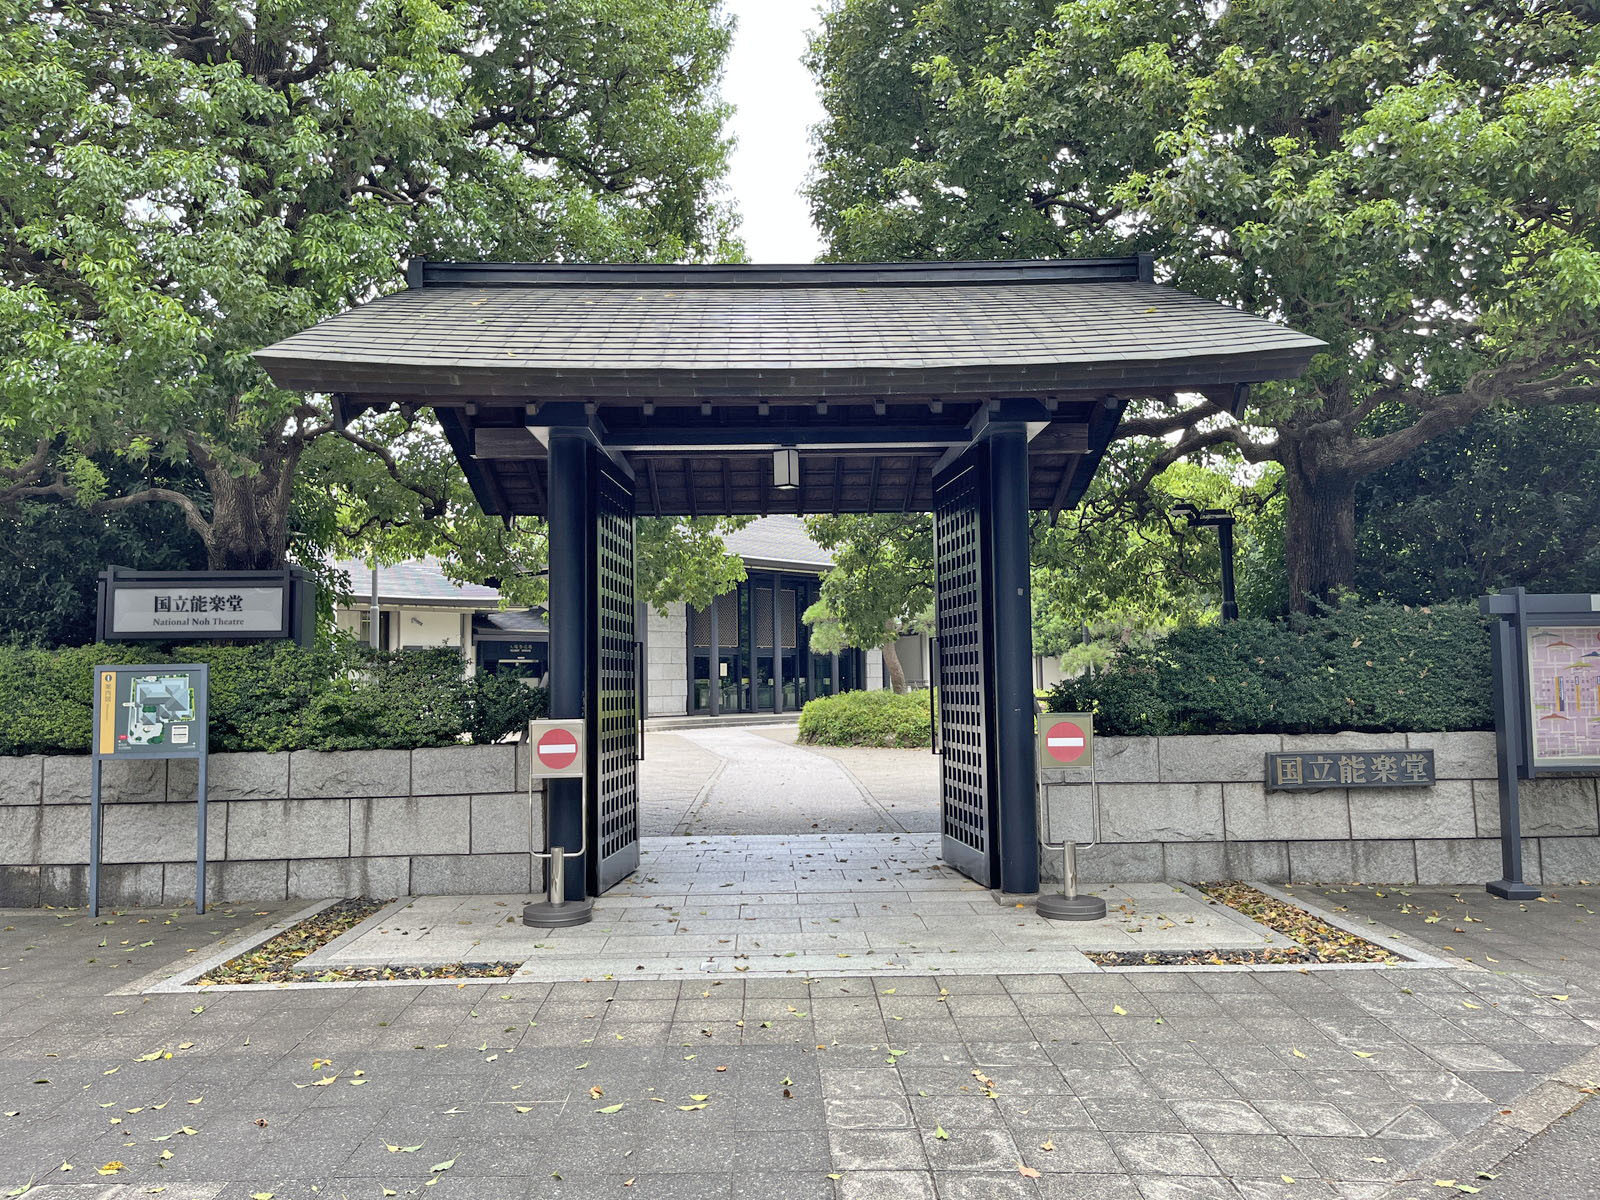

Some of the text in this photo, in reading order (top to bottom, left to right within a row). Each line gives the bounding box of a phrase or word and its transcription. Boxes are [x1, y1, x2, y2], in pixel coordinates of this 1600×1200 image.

[154, 595, 243, 613] 国立能楽堂
[153, 618, 244, 626] National Noh Theatre
[1276, 753, 1430, 785] 国立能楽堂
